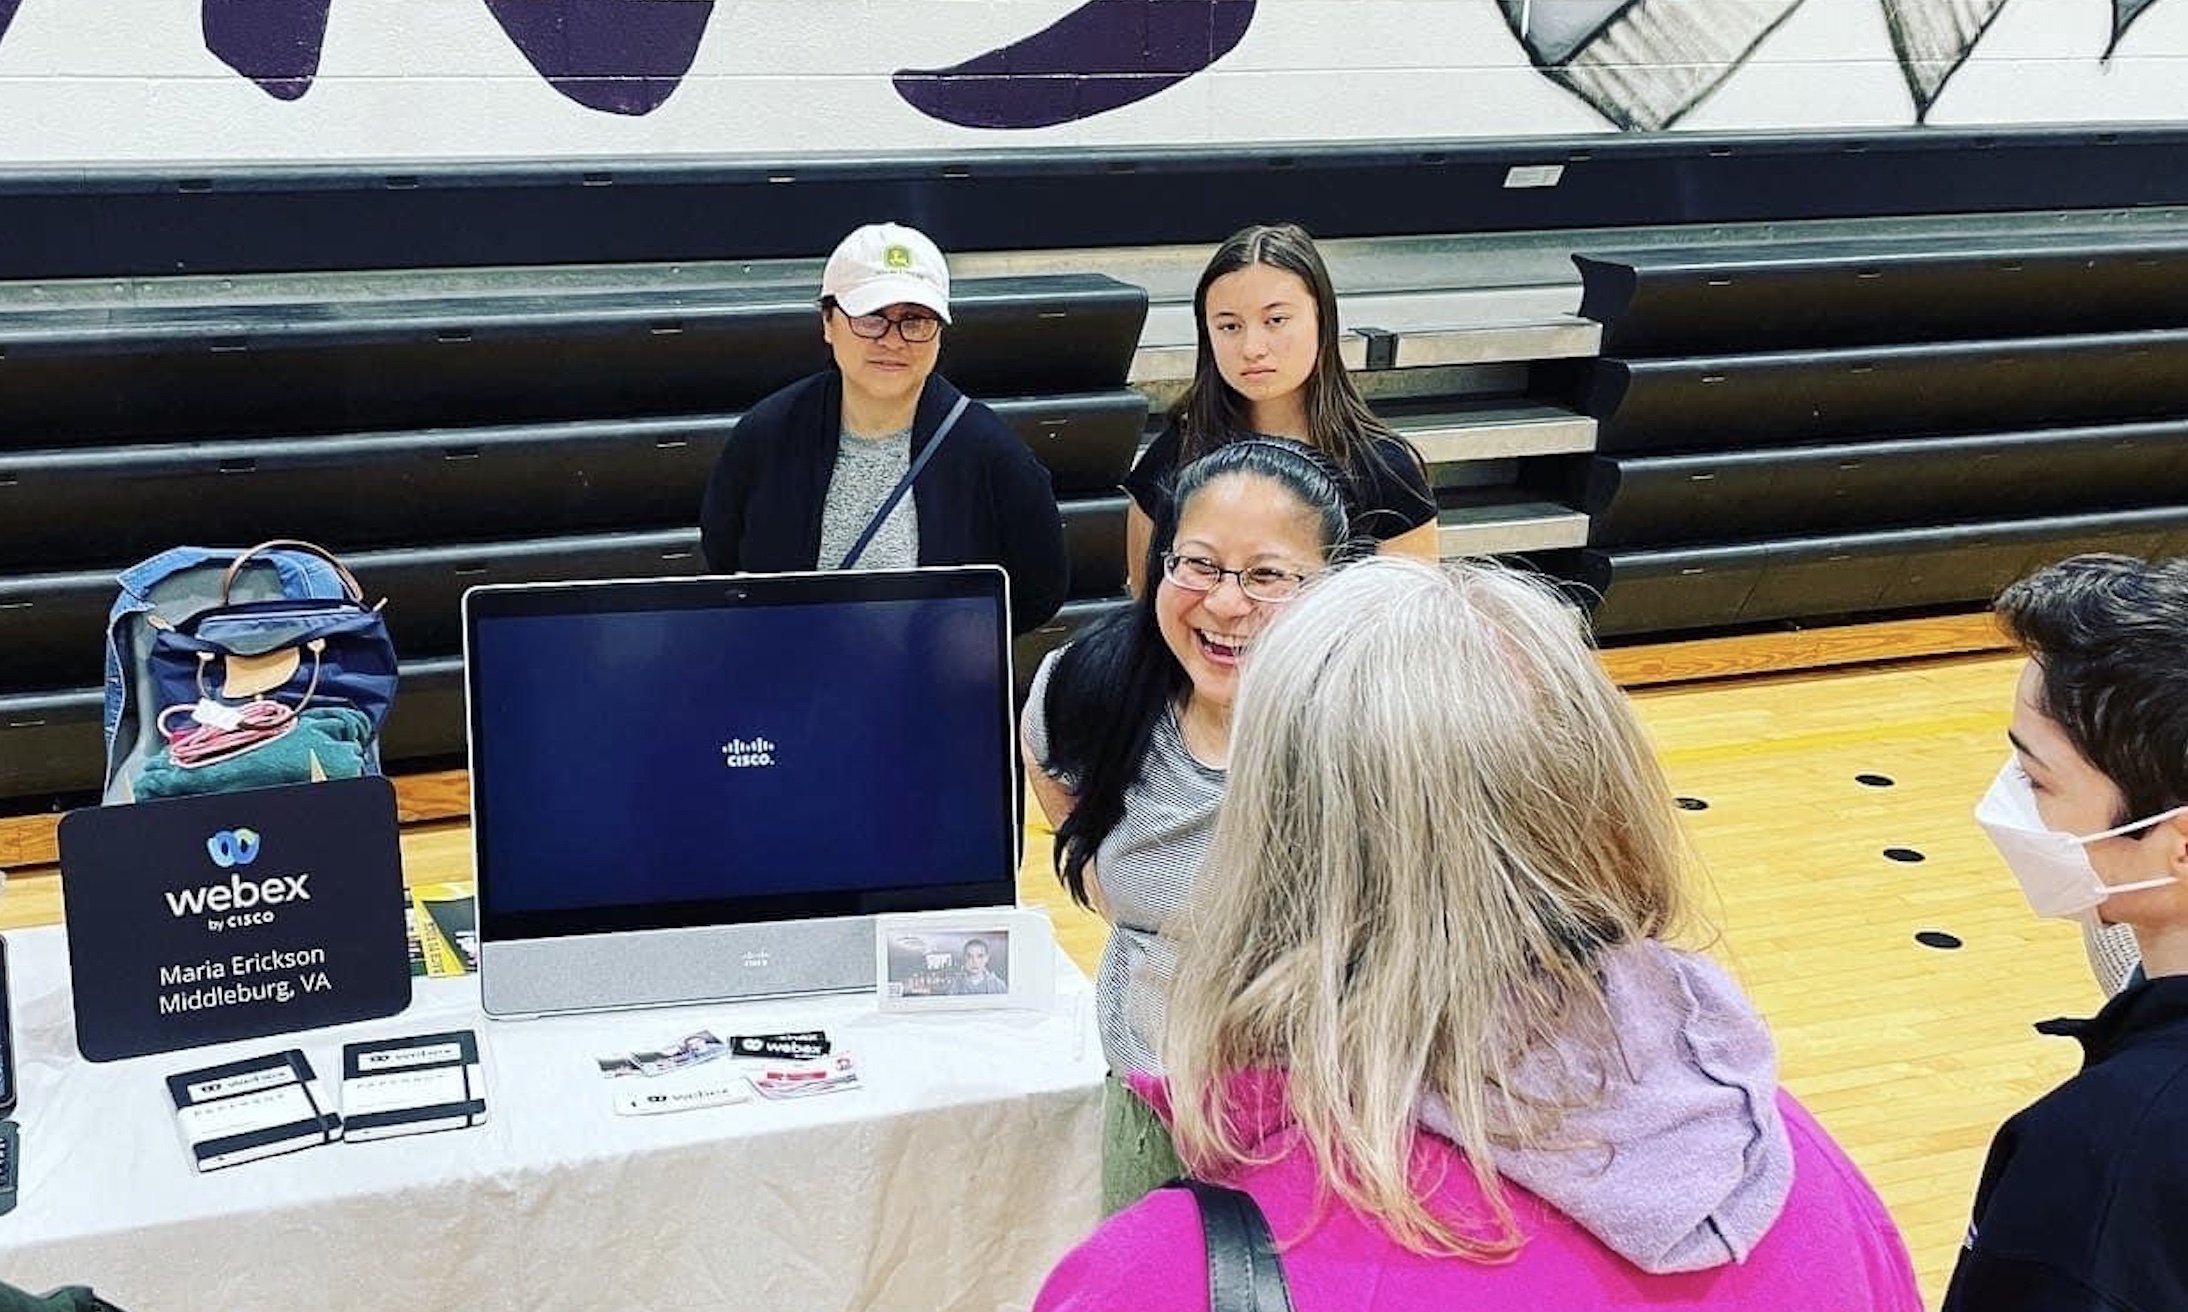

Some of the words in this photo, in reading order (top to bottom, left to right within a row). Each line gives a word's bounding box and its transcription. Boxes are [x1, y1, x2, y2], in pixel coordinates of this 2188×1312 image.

[164, 873, 311, 917] webex
[208, 917, 225, 932] by
[159, 959, 226, 986] Maria
[231, 948, 325, 976] Erickson
[159, 980, 295, 1015] Middleburg,
[299, 971, 332, 993] VA
[766, 1040, 822, 1054] webex
